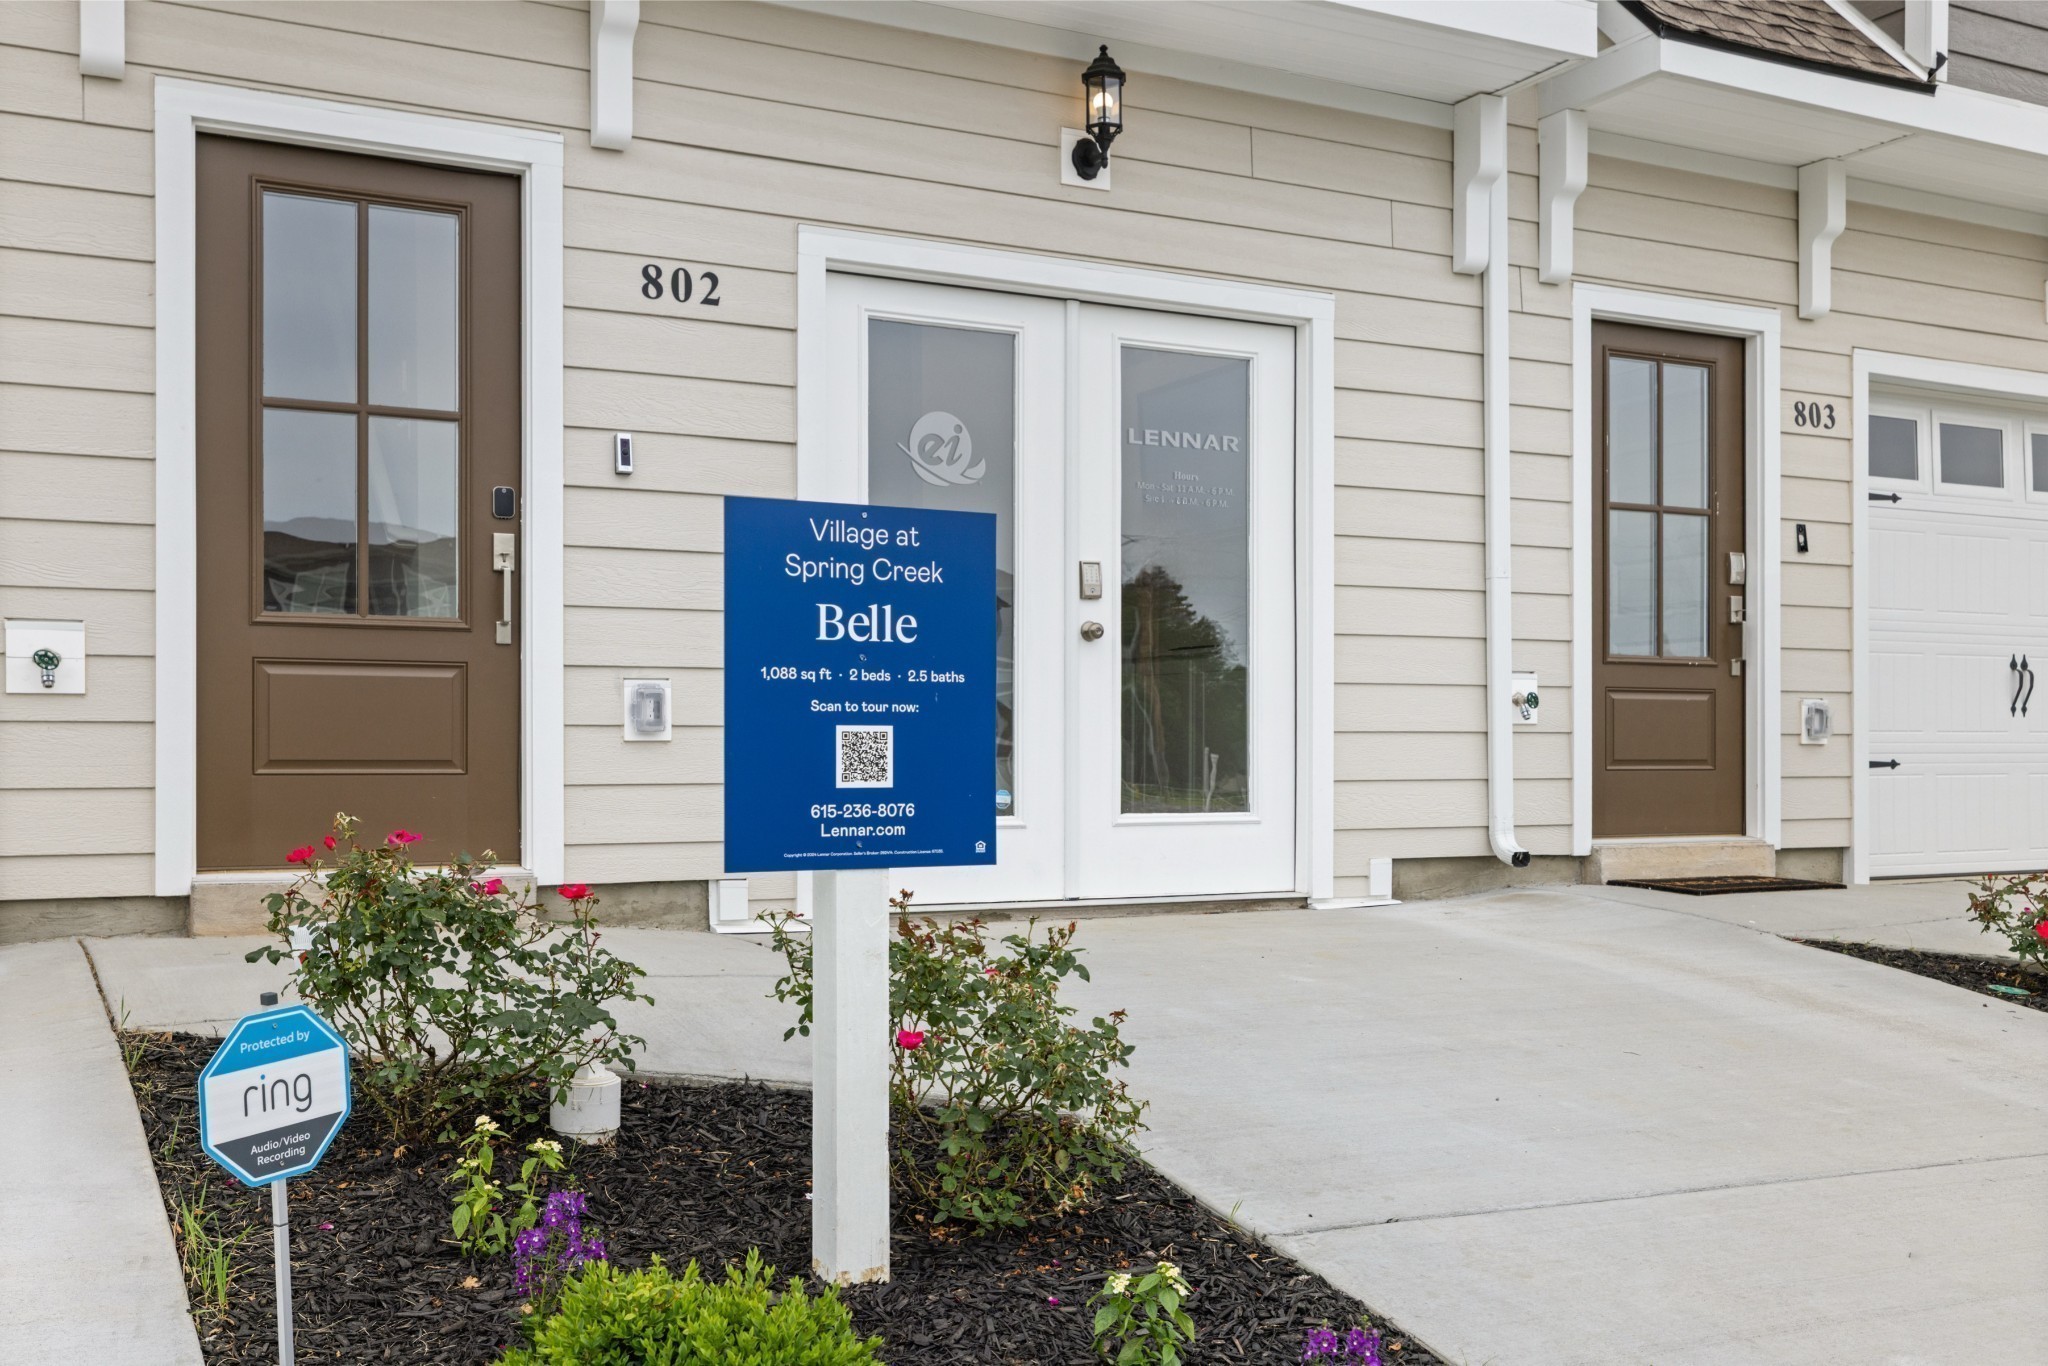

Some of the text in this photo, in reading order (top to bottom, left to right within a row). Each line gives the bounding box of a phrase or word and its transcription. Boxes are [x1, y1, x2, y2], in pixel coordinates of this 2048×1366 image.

[641, 264, 721, 306] 802
[1794, 400, 1836, 430] 803
[1128, 427, 1240, 452] LENNAR
[1174, 471, 1199, 481] Hours
[809, 517, 921, 550] Village at
[784, 553, 944, 586] Spring Creek
[815, 603, 918, 644] Belle
[760, 666, 798, 680] 1,088
[800, 670, 816, 683] sq
[818, 667, 833, 680] ft
[849, 669, 859, 681] 2
[861, 668, 892, 681] beds
[907, 669, 928, 683] 2.5
[930, 670, 966, 683] baths
[810, 700, 920, 713] Scan to tour now:
[810, 802, 915, 819] 615-236-8076
[820, 823, 906, 838] Lennar.com
[240, 1030, 311, 1054] Protected by
[243, 1073, 313, 1118] ring
[250, 1131, 311, 1156] Audio/Video
[257, 1146, 306, 1166] Recording
